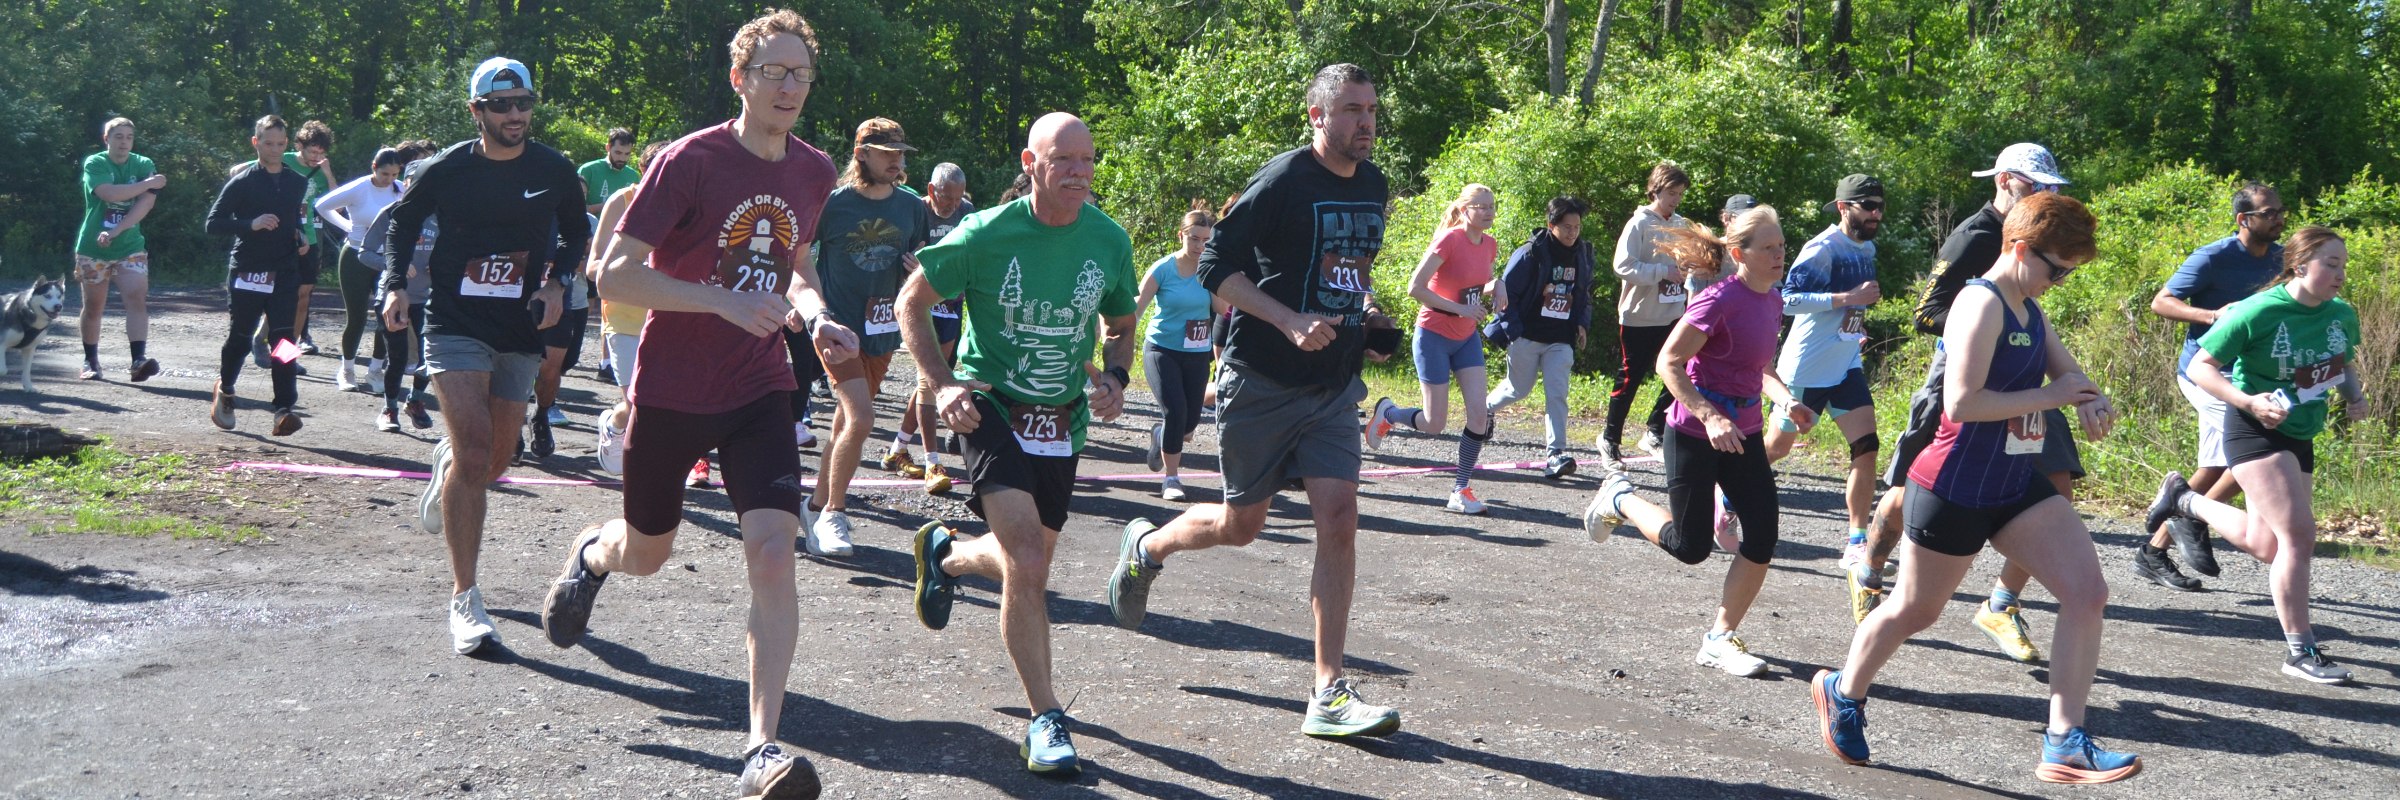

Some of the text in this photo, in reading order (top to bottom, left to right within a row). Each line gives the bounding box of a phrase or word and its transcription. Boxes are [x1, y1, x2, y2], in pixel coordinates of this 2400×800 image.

[718, 194, 799, 251] BY HOOK OR BY CROOK
[247, 271, 269, 284] 168
[480, 261, 514, 283] 152
[732, 264, 778, 294] 239
[1332, 266, 1363, 291] 231
[873, 303, 893, 322] 235
[1549, 298, 1568, 312] 237
[1193, 325, 1207, 340] 170
[2311, 364, 2331, 384] 97
[1023, 413, 1059, 439] 225
